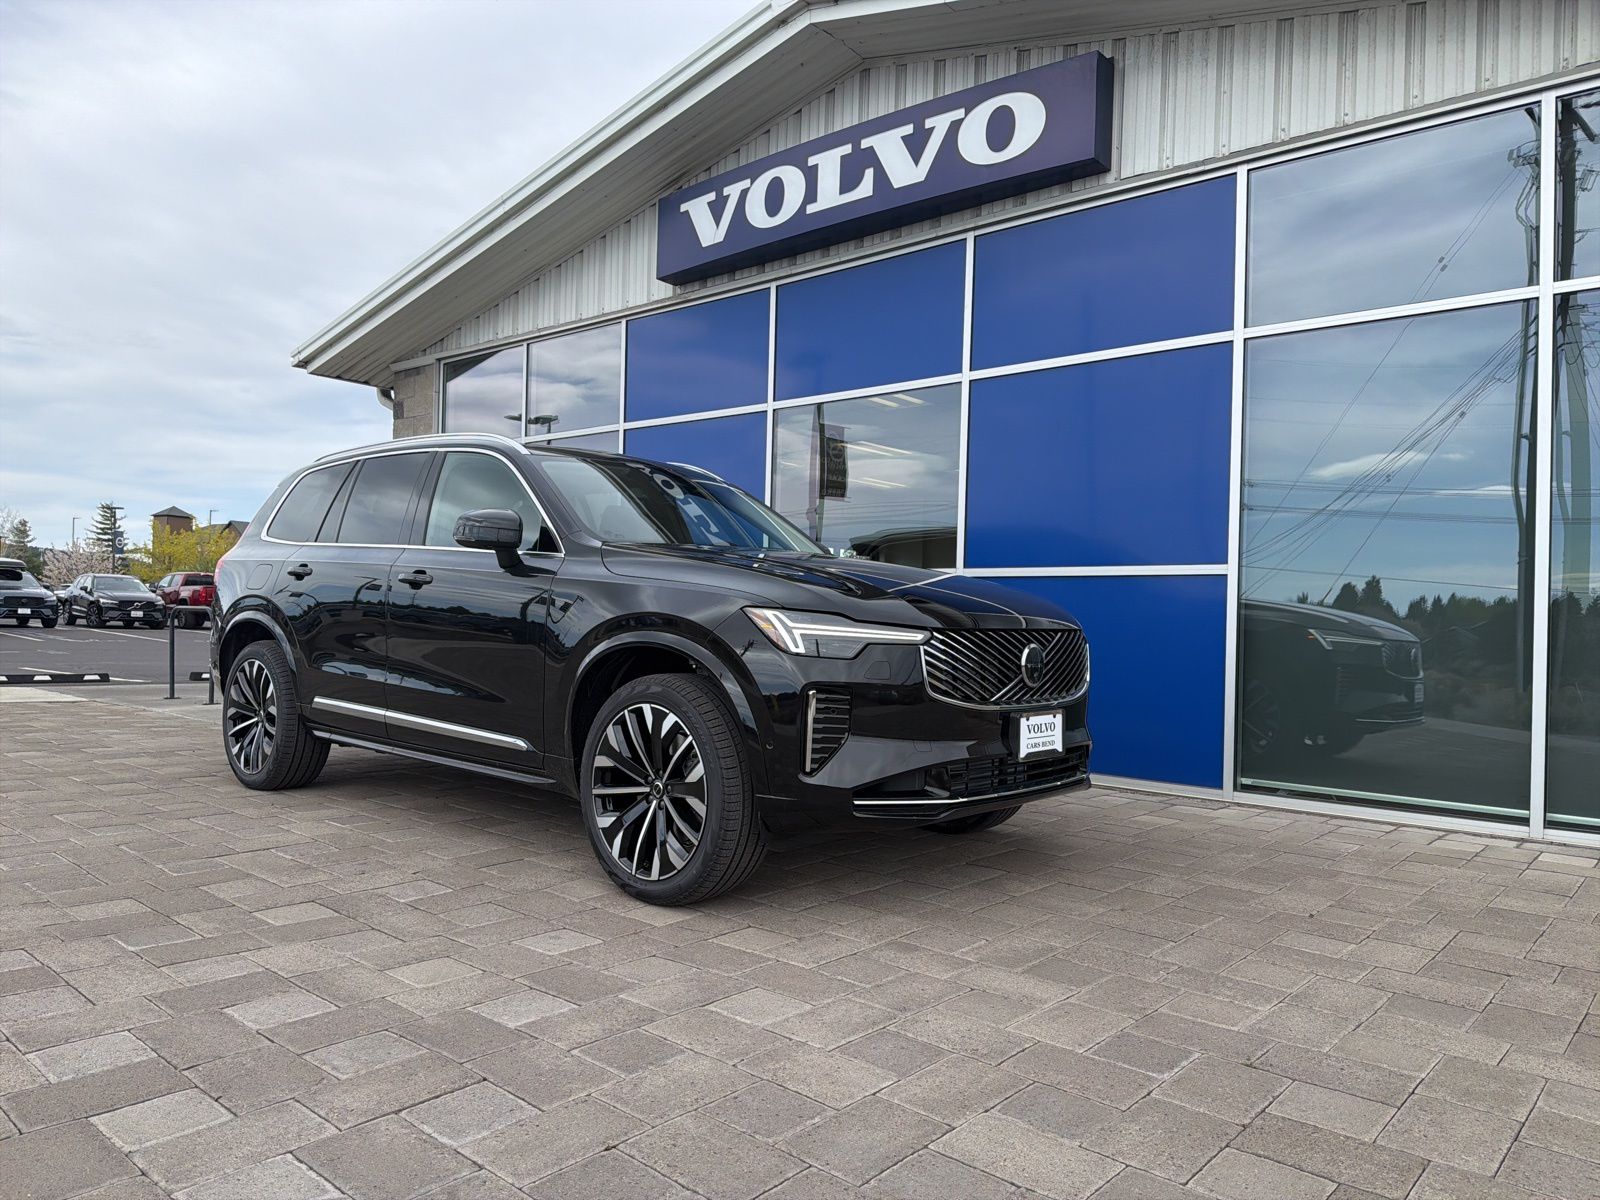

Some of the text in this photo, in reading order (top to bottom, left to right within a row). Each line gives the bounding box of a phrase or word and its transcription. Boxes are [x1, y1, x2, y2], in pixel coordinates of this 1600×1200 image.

[680, 91, 1047, 248] VOLVO
[1026, 721, 1056, 735] VOLVO
[1026, 740, 1056, 750] CARS BEND
